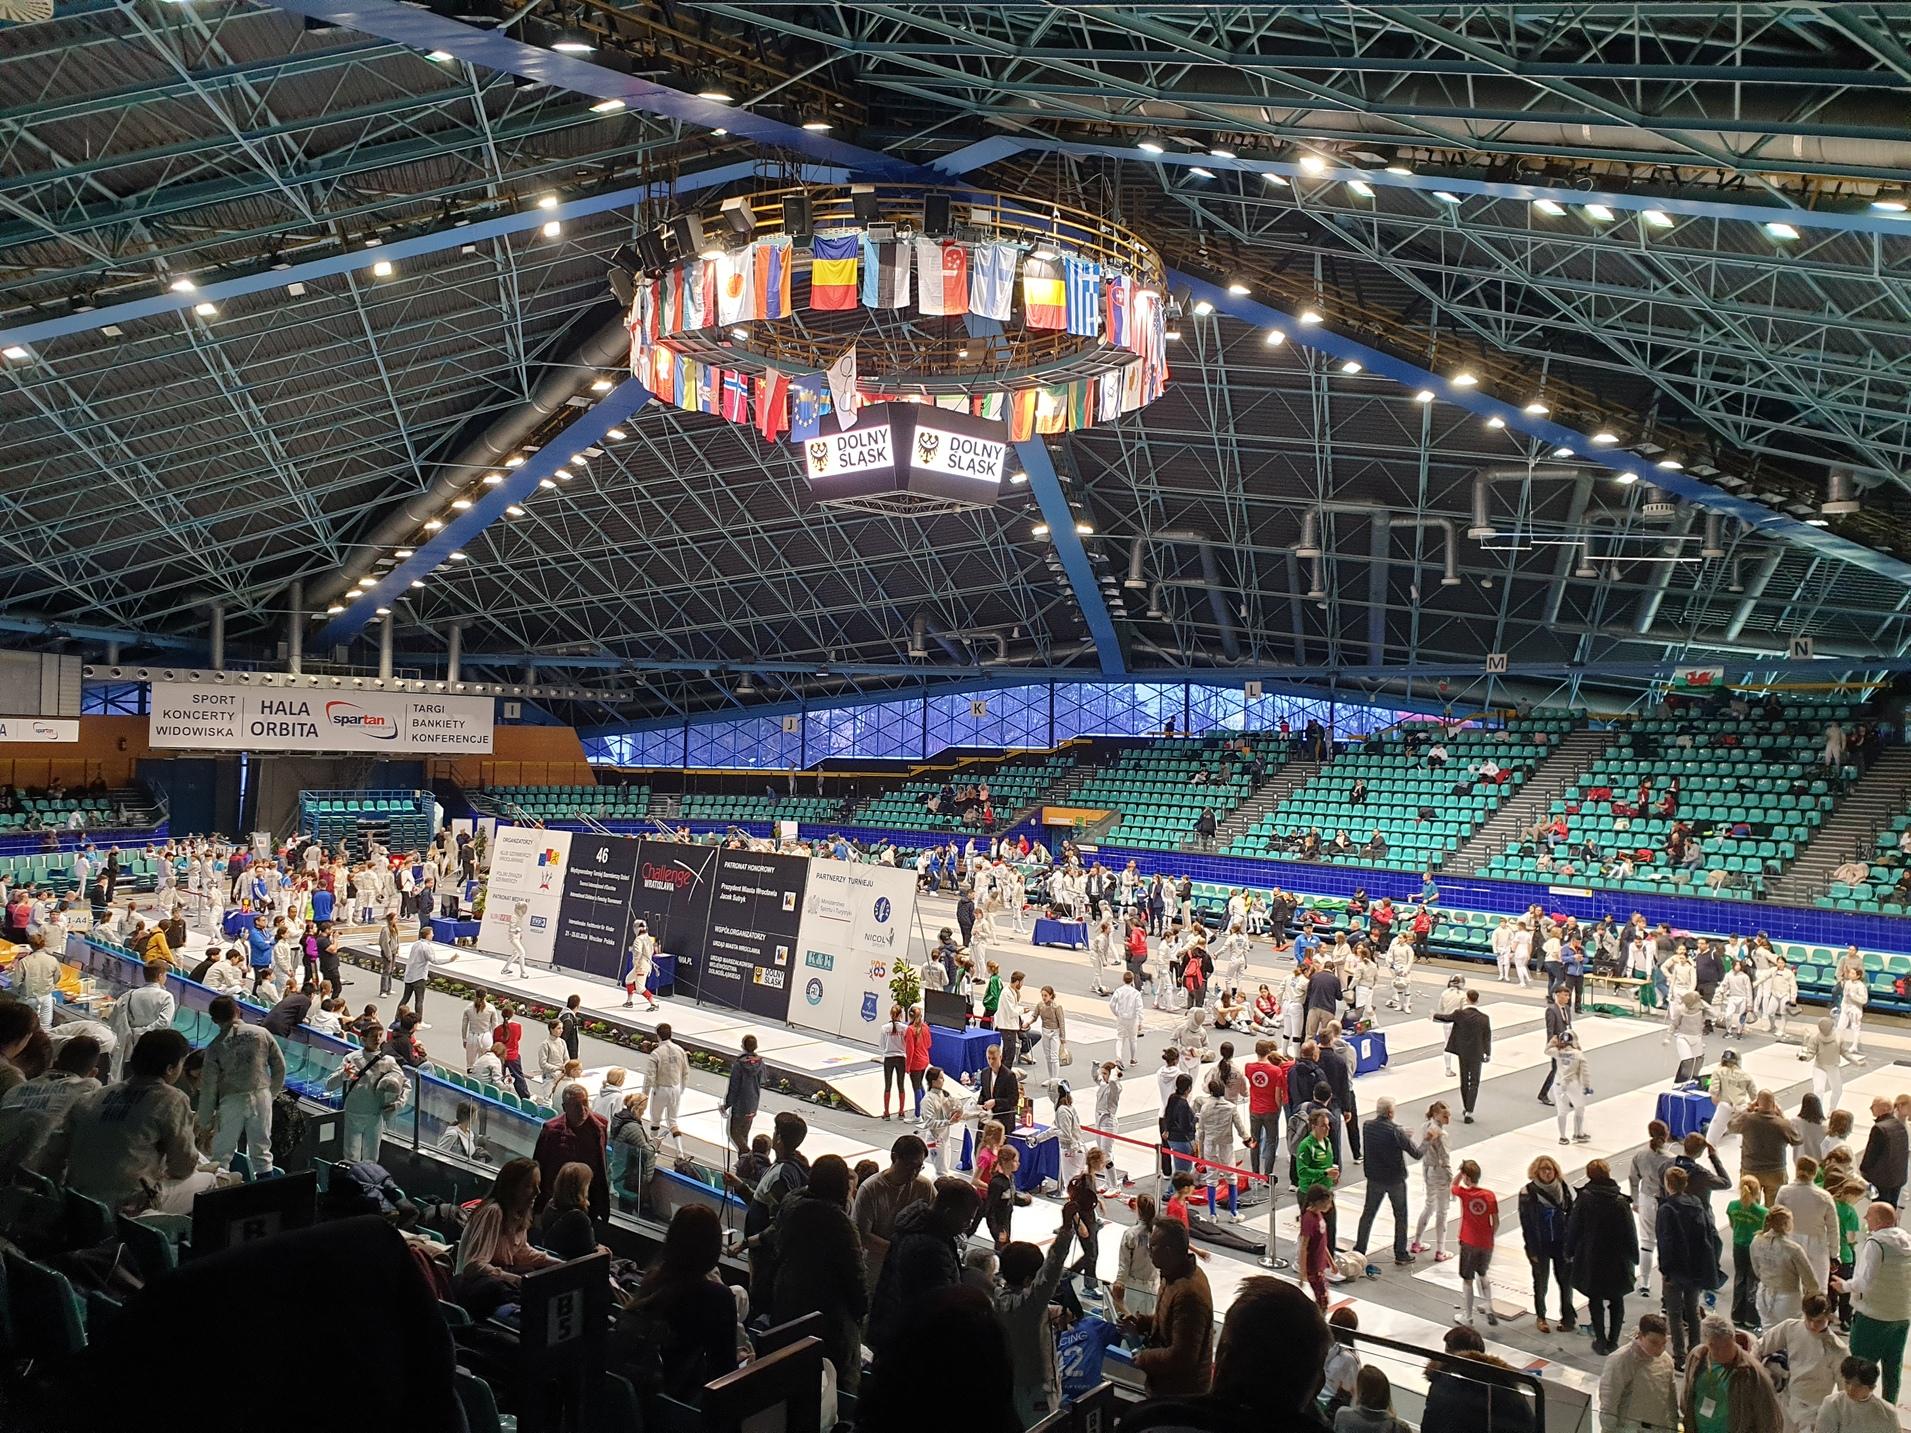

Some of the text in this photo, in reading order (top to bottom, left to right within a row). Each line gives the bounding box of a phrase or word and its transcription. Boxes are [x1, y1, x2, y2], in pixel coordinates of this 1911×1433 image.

[837, 428, 888, 451] DOLNY
[950, 437, 1003, 460] DOLNY
[839, 446, 888, 468] ŚLĄSK
[948, 451, 997, 476] ŚLĄSK
[1795, 641, 1808, 656] N
[1489, 656, 1504, 669] M
[1250, 684, 1257, 696] L
[192, 694, 236, 705] SPORT
[260, 700, 311, 716] HALA
[413, 704, 445, 714] TARGI
[974, 703, 982, 714] K
[162, 709, 236, 721] KONCERTY
[333, 714, 385, 727] spartan
[250, 721, 319, 738] ORBITA
[412, 719, 466, 729] BANKIETY
[787, 719, 793, 730] J
[156, 726, 234, 737] WIDOWISKA
[411, 734, 489, 744] KONFERENCJE
[596, 847, 610, 864] 46
[724, 861, 775, 874] PATRONAT HONOROWY
[641, 862, 692, 888] Challenge
[815, 872, 874, 888] PARTNERZY TURNIEJU
[764, 968, 786, 978] DOLNY
